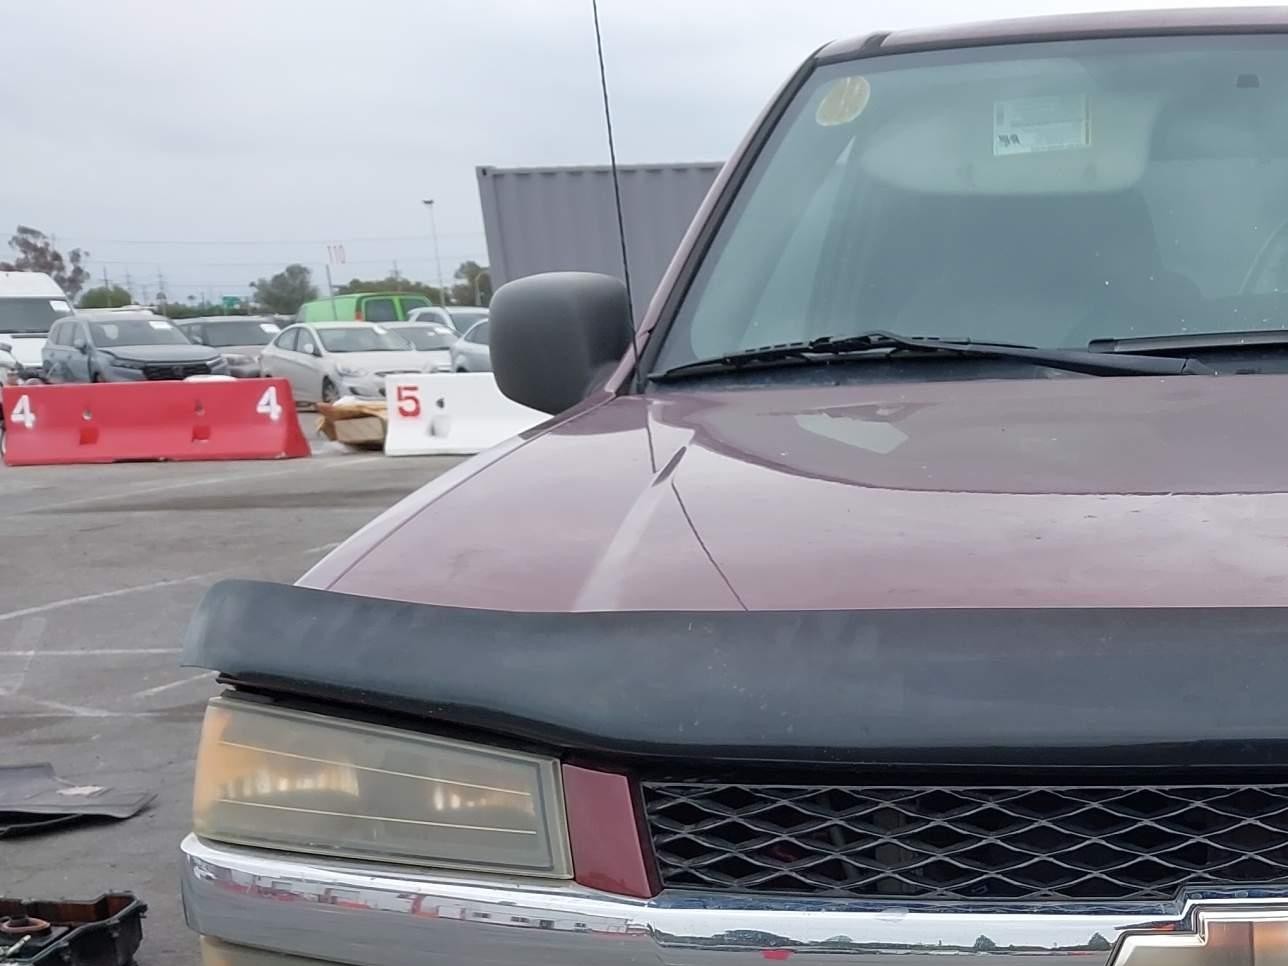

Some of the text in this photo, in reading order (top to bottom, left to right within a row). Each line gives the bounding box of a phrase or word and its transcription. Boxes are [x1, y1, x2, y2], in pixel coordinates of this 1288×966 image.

[10, 394, 37, 429] 4
[256, 386, 283, 421] 4
[396, 385, 422, 418] 5
